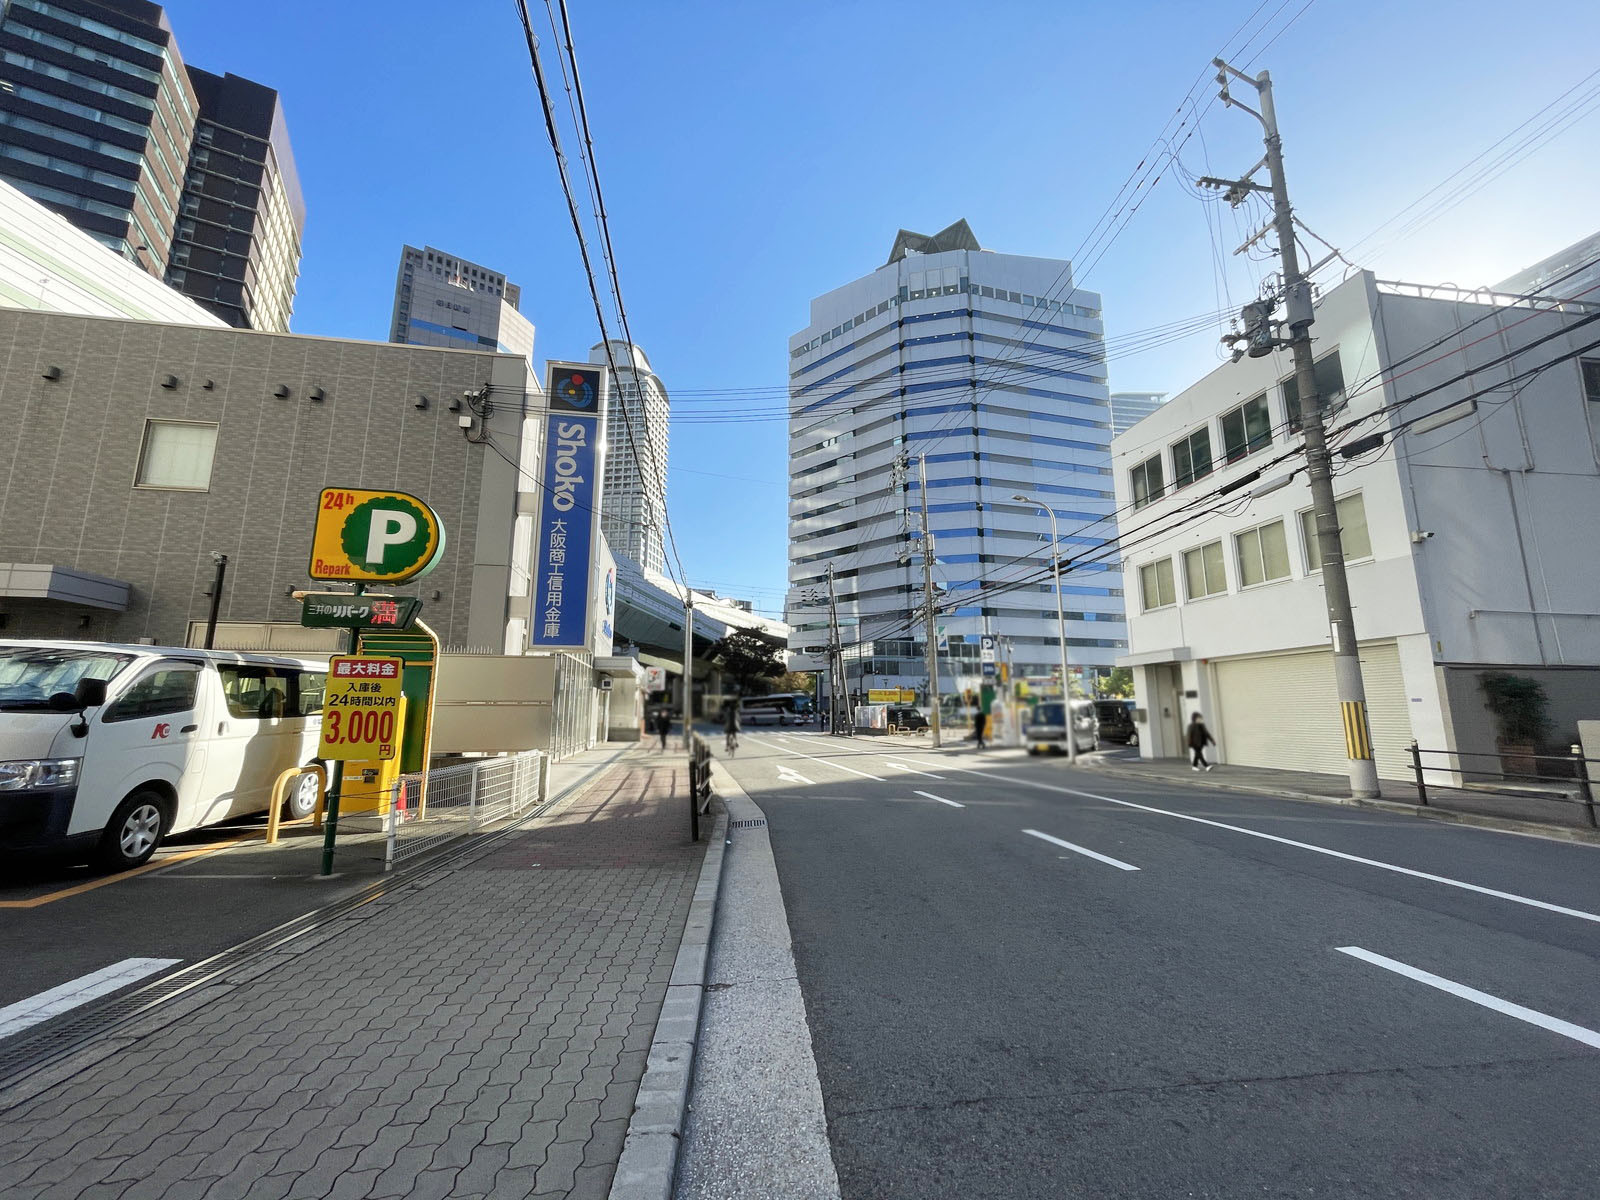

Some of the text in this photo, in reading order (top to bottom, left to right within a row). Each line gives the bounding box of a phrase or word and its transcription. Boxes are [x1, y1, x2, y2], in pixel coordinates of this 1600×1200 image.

[552, 422, 587, 513] Shoko
[323, 491, 354, 510] 24h
[365, 508, 417, 565] P
[315, 559, 351, 577] Repark
[543, 518, 568, 638] 大阪商工信用金庫
[307, 600, 398, 625] 三井のリパーク 満
[337, 662, 396, 677] 最大料金
[346, 682, 382, 693] 入庫後
[328, 693, 396, 708] 24時間以内
[324, 710, 394, 745] 3,000
[378, 744, 391, 756] 円
